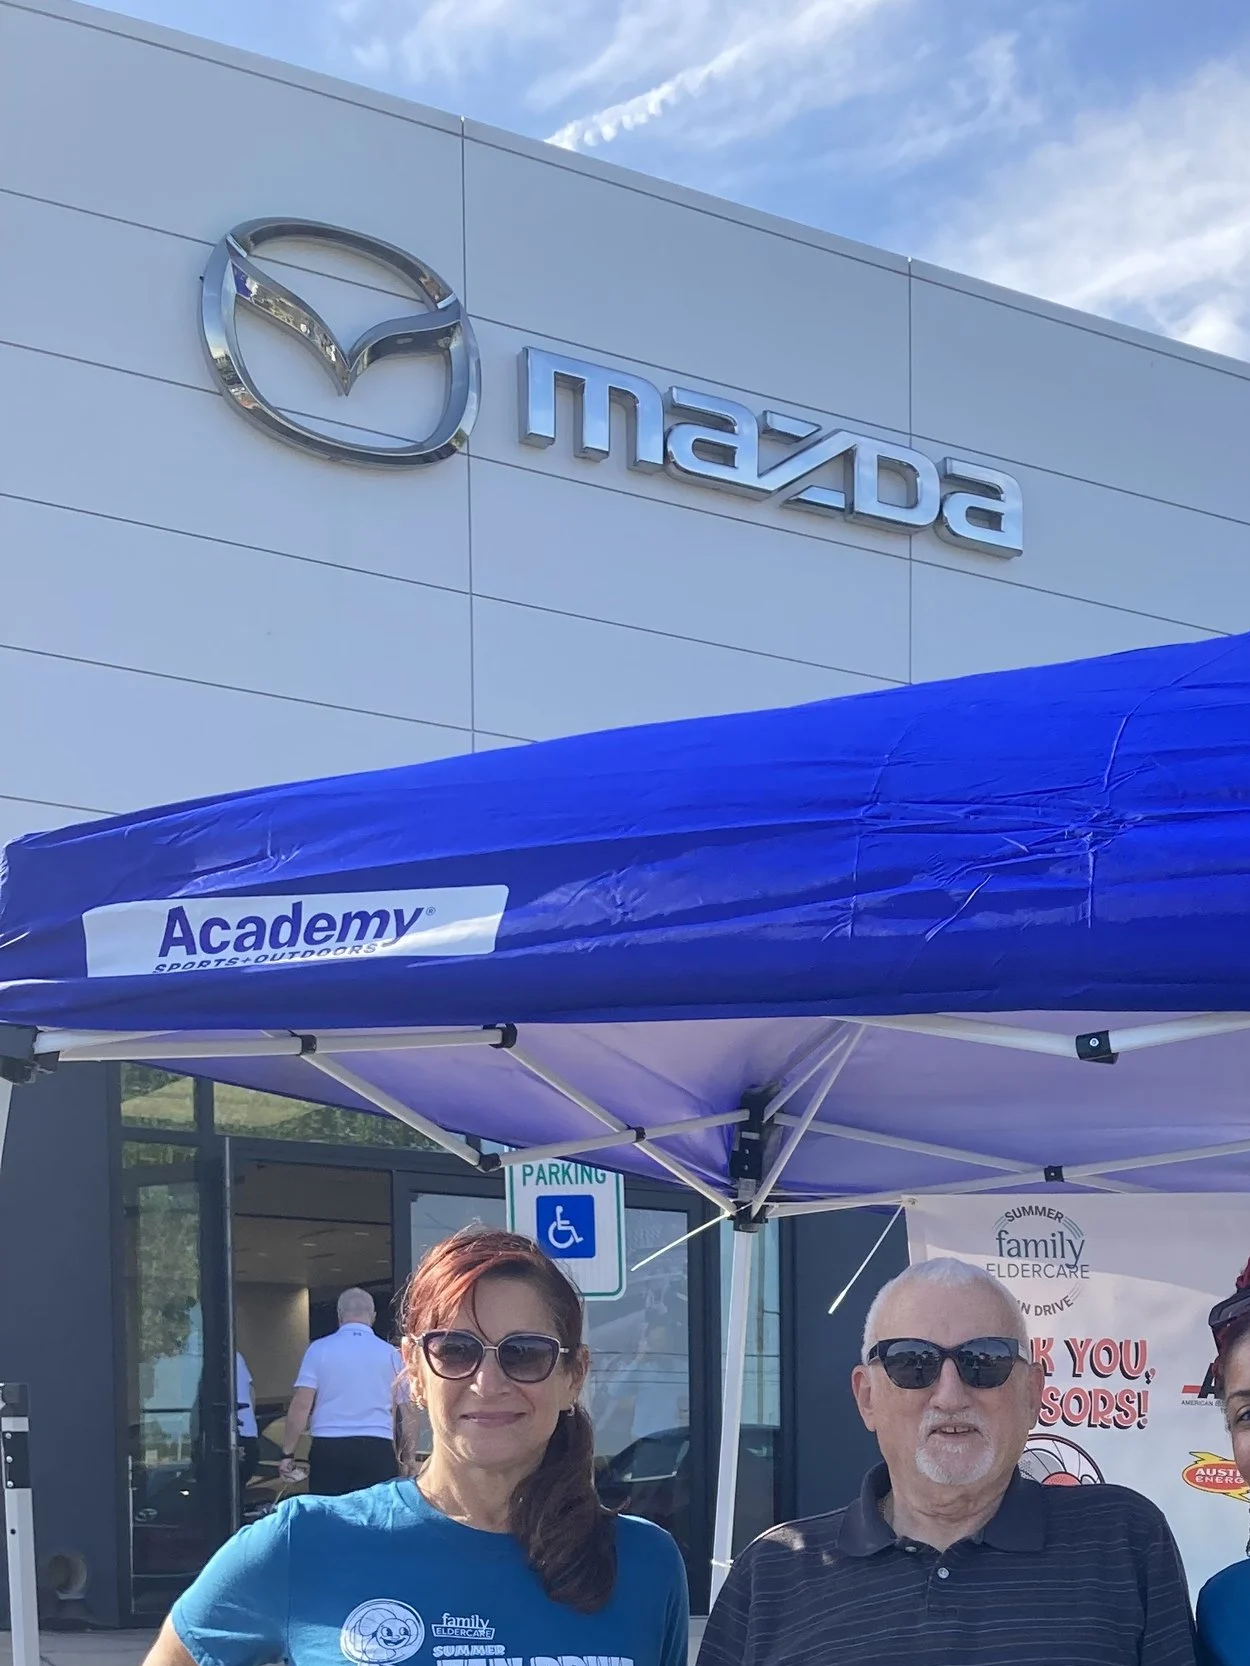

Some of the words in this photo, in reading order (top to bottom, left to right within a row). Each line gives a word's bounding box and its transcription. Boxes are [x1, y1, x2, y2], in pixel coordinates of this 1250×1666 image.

[522, 1163, 606, 1186] PARKING
[1005, 1205, 1064, 1223] SUMMER
[996, 1229, 1085, 1269] family
[986, 1263, 1091, 1279] ELDERCARE
[1034, 1295, 1074, 1316] DRIVE
[1064, 1337, 1156, 1385] YOU,
[1038, 1386, 1150, 1430] SORS!
[1195, 1468, 1241, 1477] AUSTI
[1195, 1476, 1245, 1484] ENERG
[442, 1612, 490, 1631] family
[436, 1627, 491, 1638] ELDERCARE
[432, 1644, 505, 1658] SUMMER
